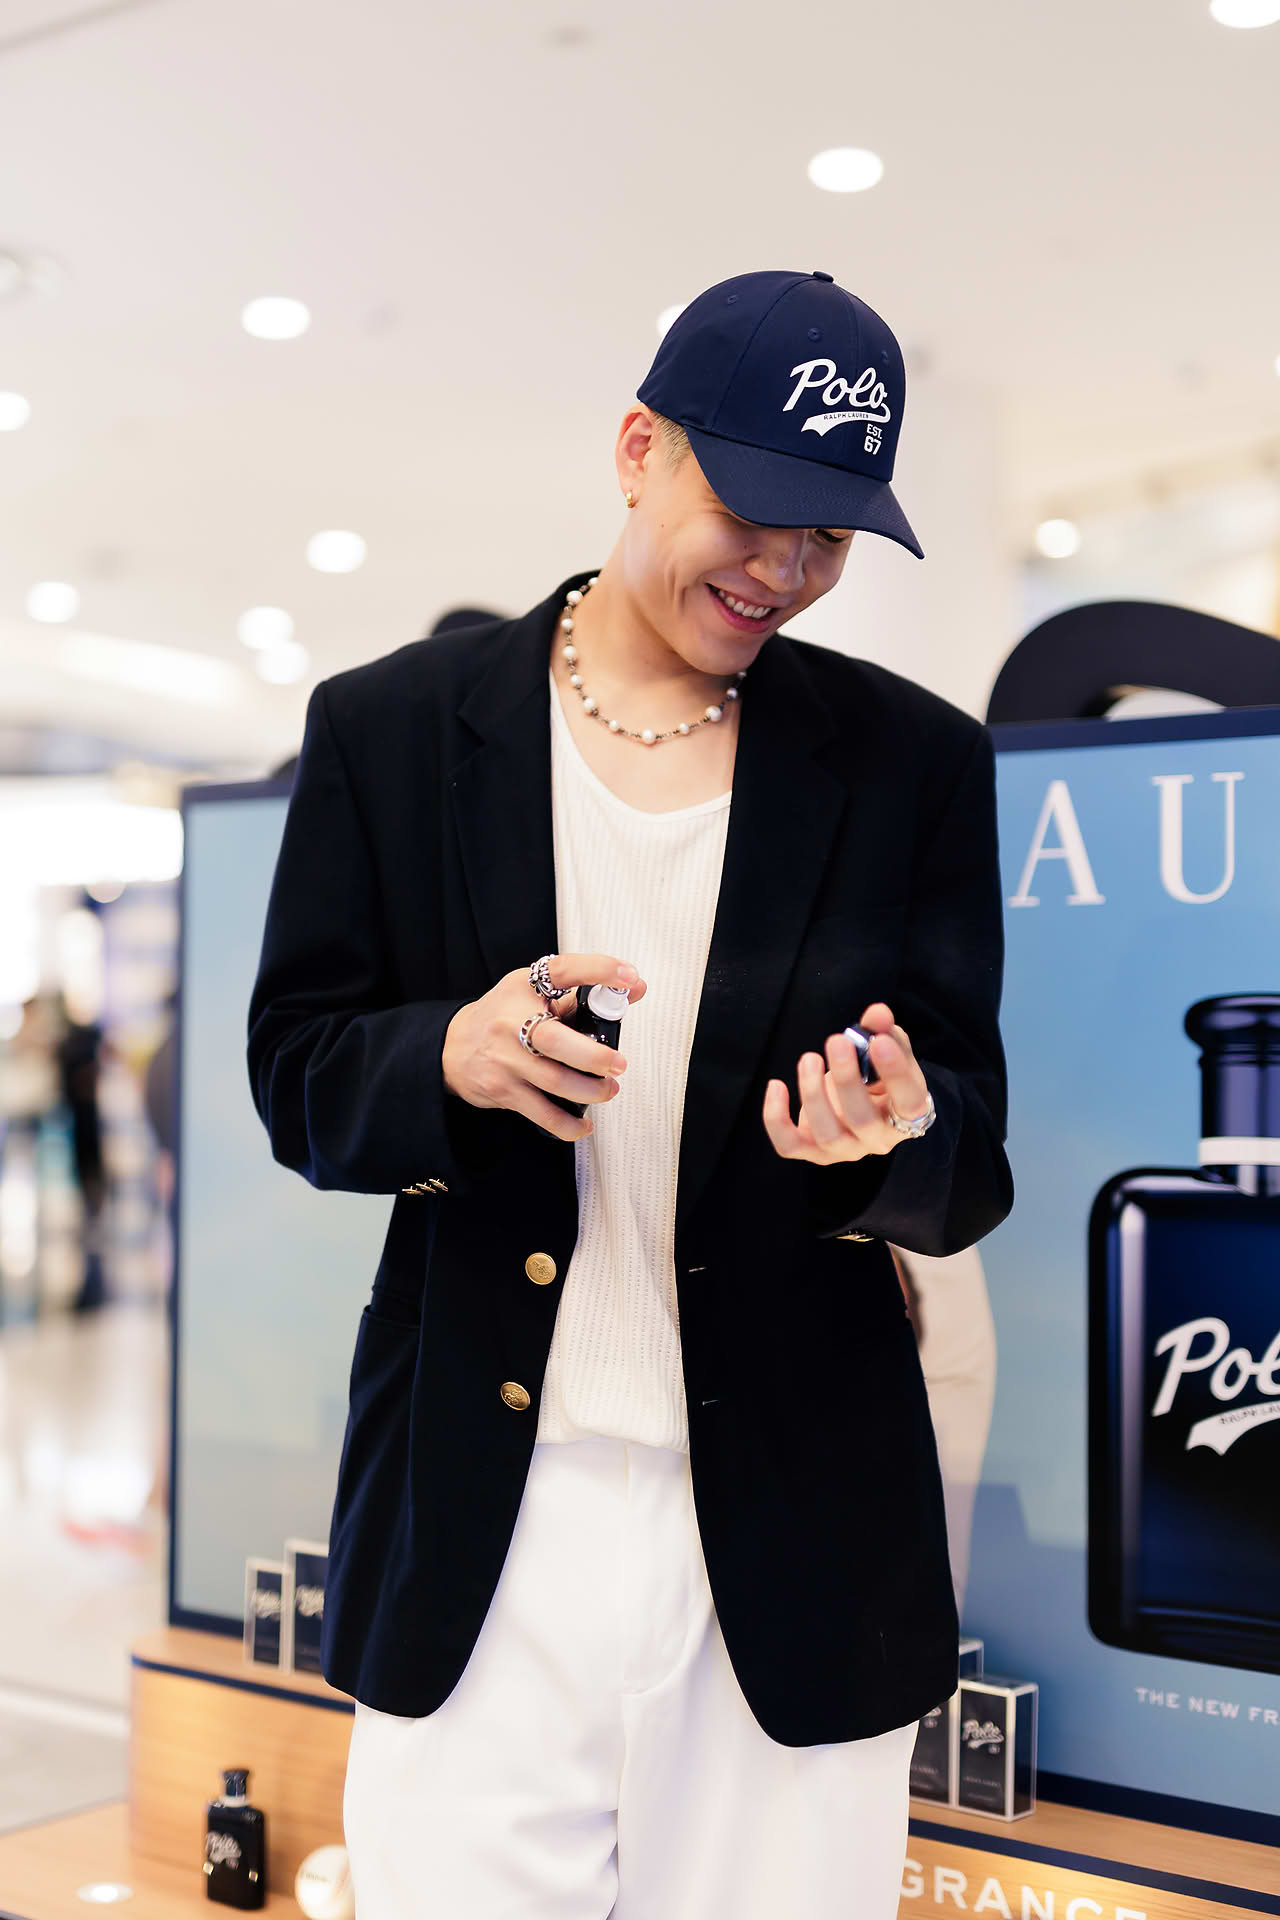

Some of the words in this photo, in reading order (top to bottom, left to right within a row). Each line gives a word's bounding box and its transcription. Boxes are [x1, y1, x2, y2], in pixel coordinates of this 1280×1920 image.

[783, 358, 888, 412] Polo
[823, 412, 847, 421] RALPH
[866, 423, 883, 440] EST.
[864, 436, 882, 455] 67
[1135, 1687, 1180, 1709] THE
[1188, 1696, 1240, 1719] NEW
